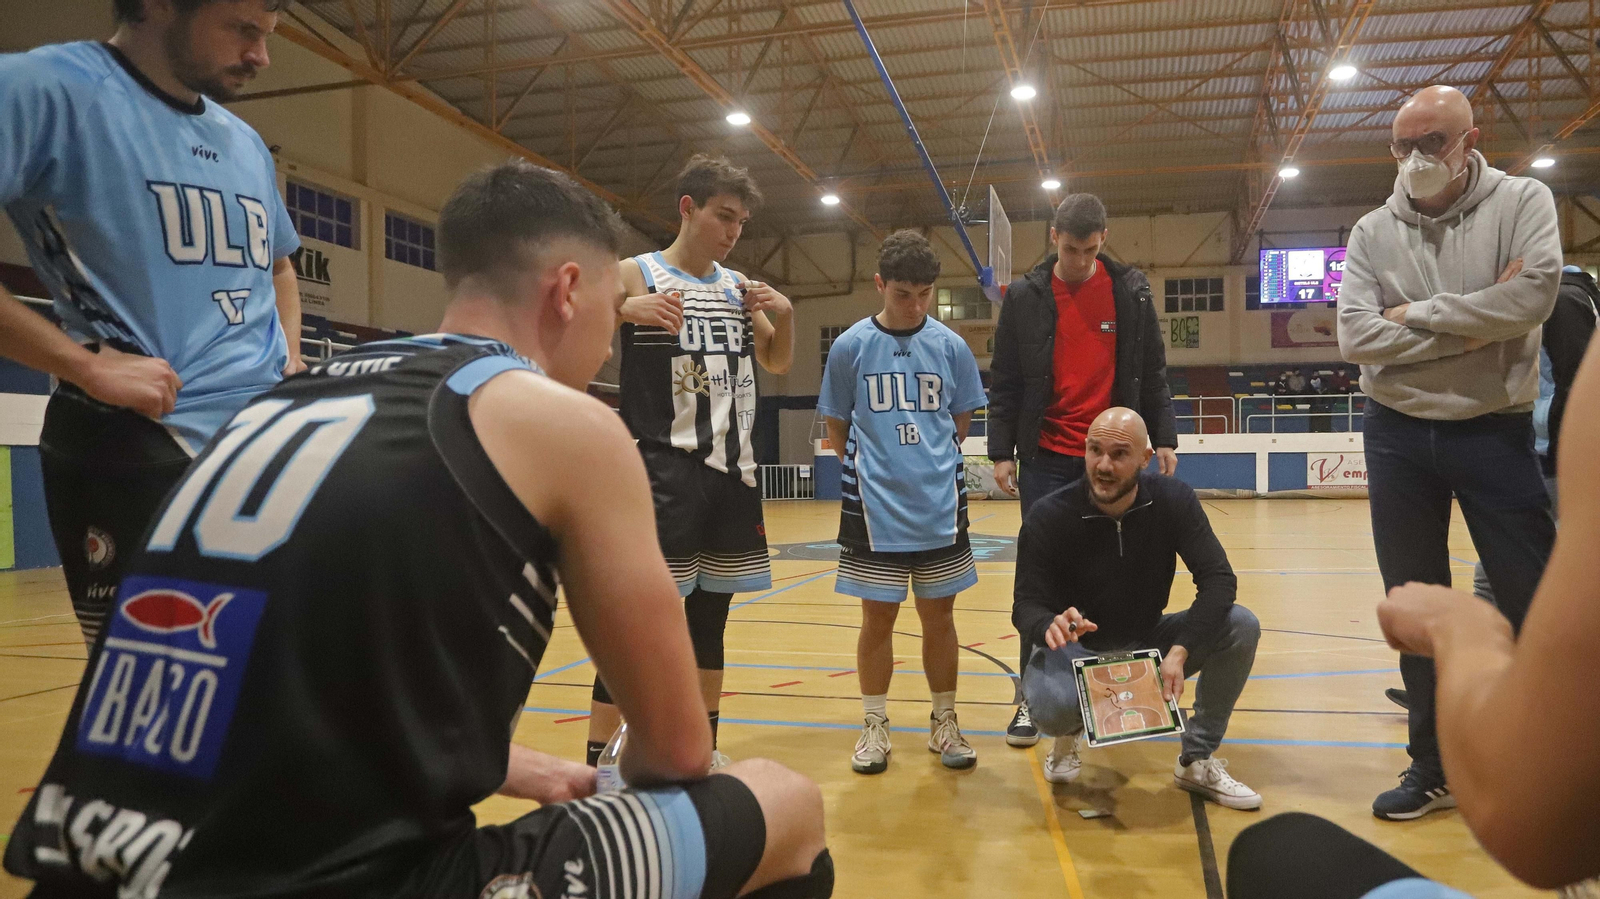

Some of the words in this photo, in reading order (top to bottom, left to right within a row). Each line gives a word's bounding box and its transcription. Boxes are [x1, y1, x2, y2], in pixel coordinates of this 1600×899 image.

[191, 145, 219, 162] vive
[146, 180, 271, 271] ULB
[1298, 288, 1315, 299] 17
[679, 316, 743, 354] ULB
[893, 349, 912, 358] vive
[863, 372, 943, 413] ULB
[896, 422, 921, 445] 18
[146, 394, 377, 562] 10
